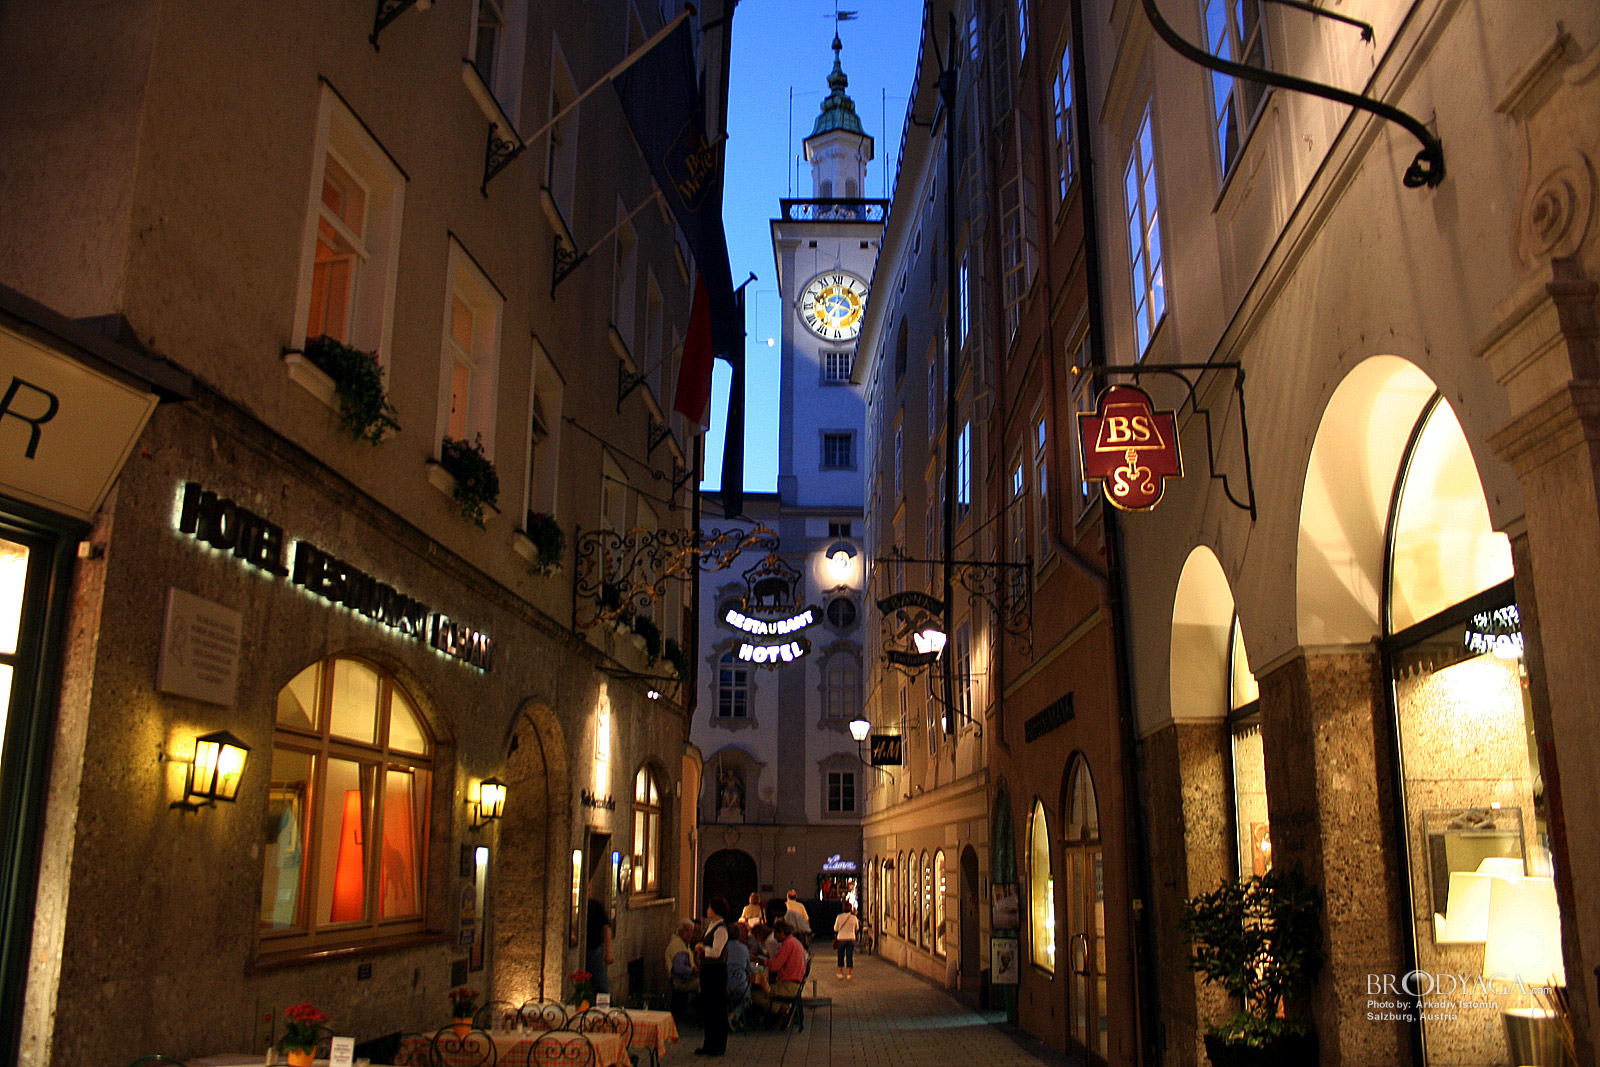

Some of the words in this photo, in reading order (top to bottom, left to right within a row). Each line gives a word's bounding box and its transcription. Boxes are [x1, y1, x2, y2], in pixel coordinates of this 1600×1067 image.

[832, 275, 843, 285] XII
[0, 375, 60, 460] R
[1106, 415, 1151, 443] BS
[179, 481, 290, 577] HOTEL
[292, 540, 432, 643] RESTAURANT
[891, 593, 931, 610] BANK
[725, 609, 814, 635] RESTAURANT
[738, 641, 804, 664] HOTEL
